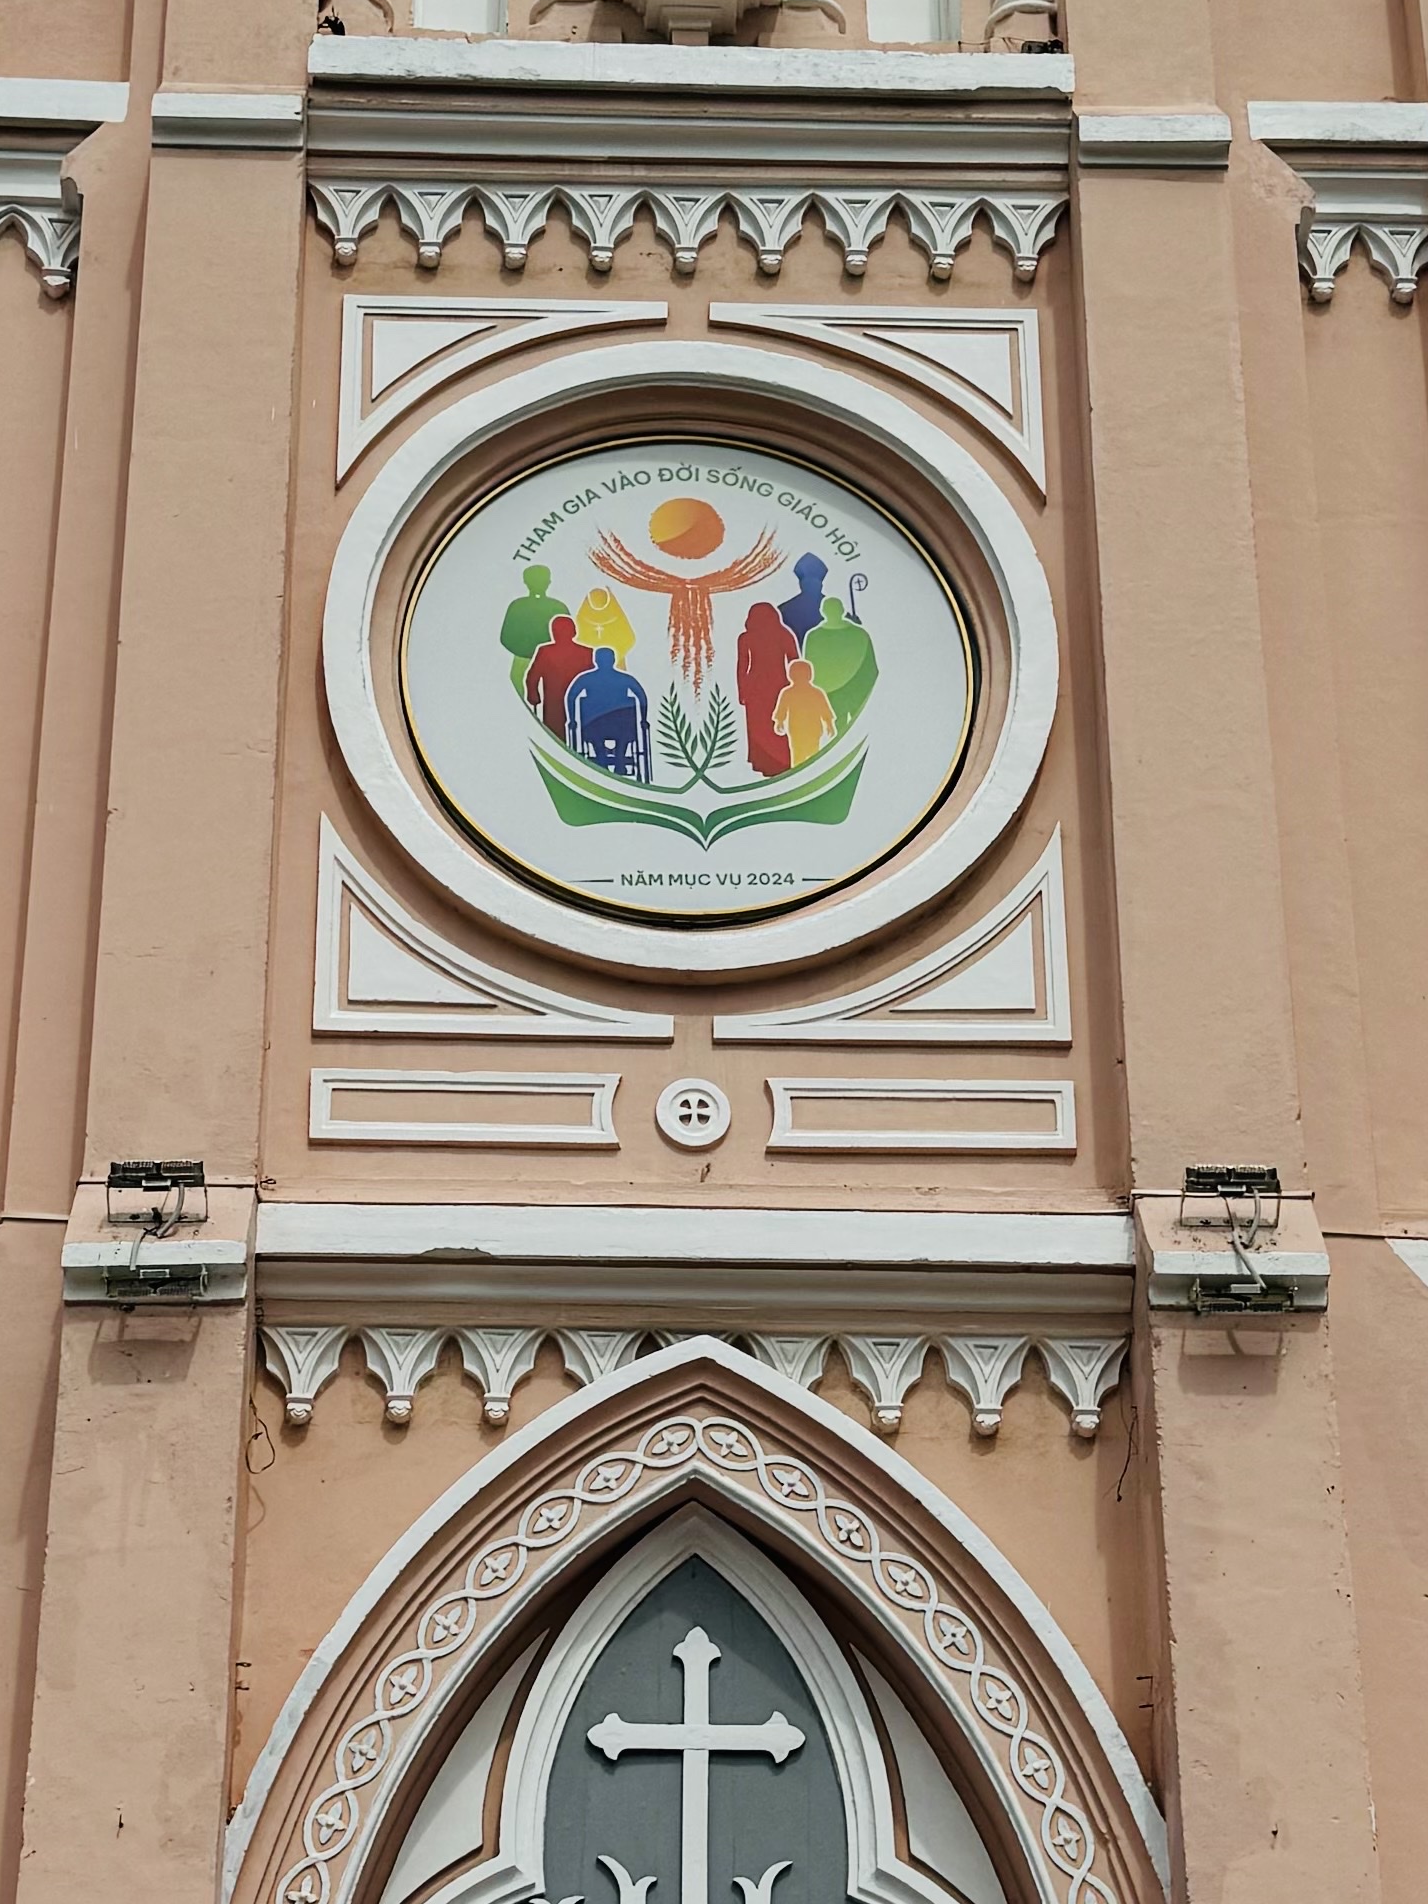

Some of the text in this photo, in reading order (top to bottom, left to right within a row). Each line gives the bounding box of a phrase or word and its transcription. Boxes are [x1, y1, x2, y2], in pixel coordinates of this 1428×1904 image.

[512, 462, 861, 562] THAM GIA VÀO ĐỜI SỐNG GIÁO HỘI
[620, 870, 795, 890] NĂM MỤC VỤ 2024
